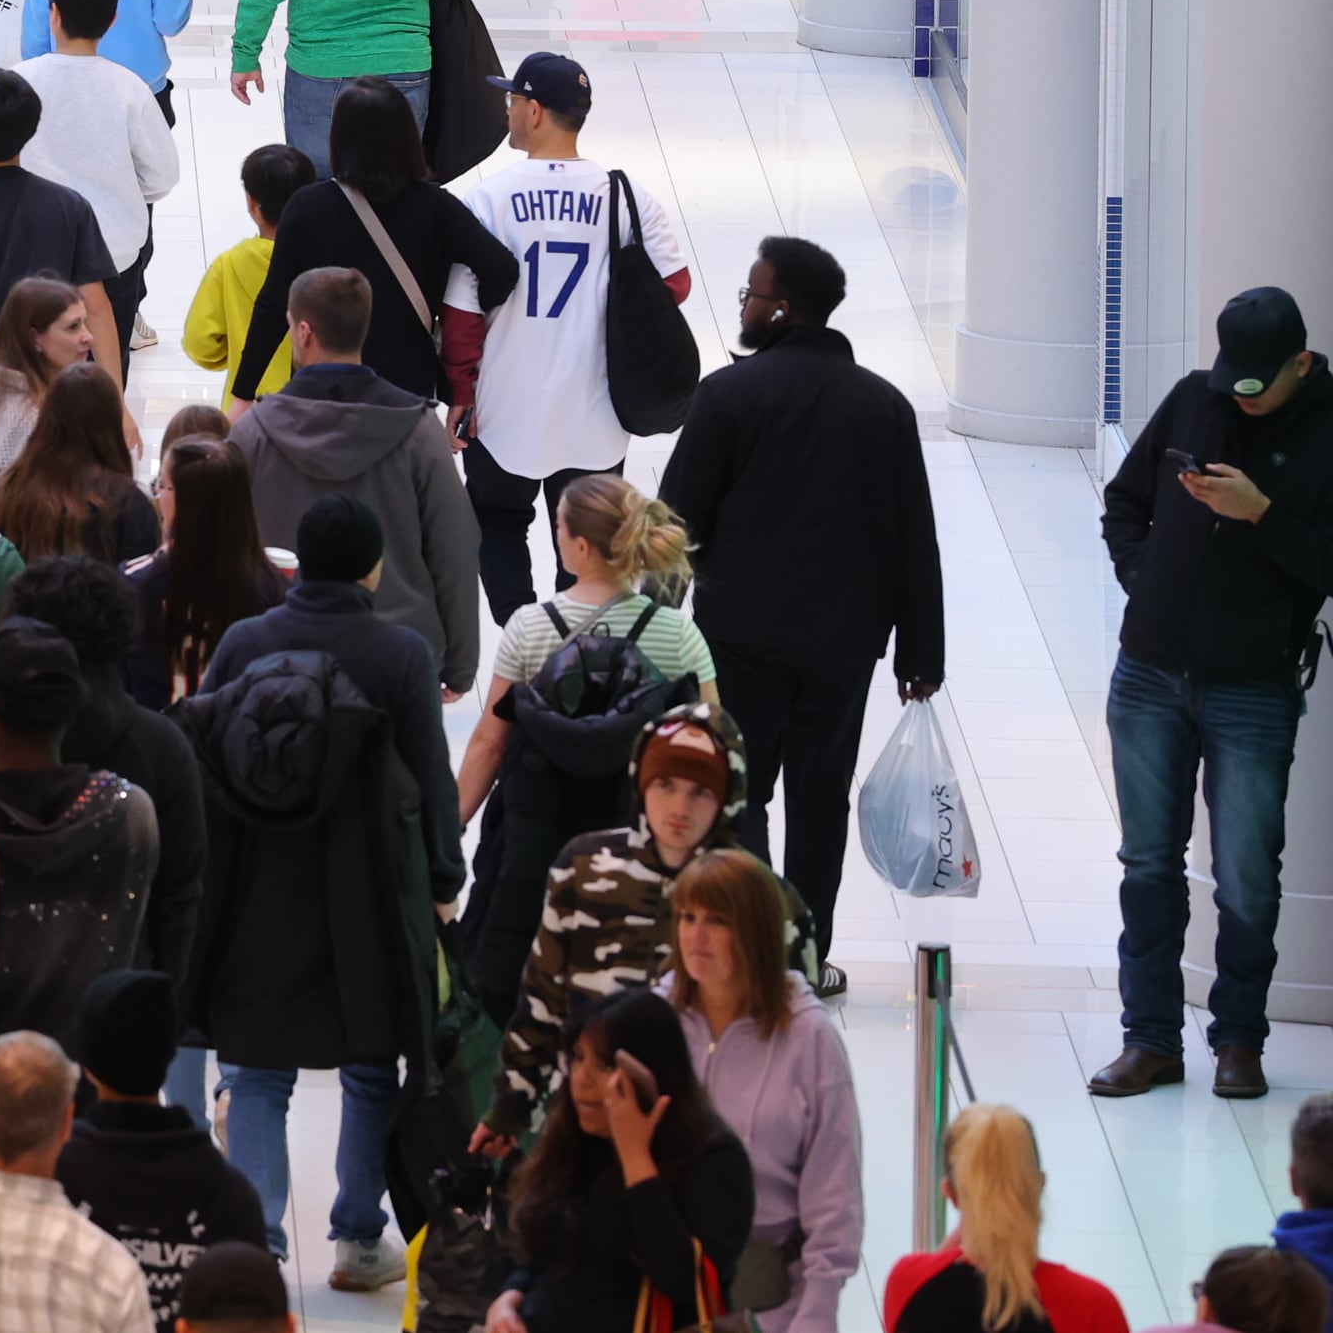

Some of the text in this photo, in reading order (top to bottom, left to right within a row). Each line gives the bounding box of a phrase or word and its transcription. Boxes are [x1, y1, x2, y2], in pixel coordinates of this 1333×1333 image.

[510, 189, 602, 227] OHTANI
[523, 240, 590, 318] 17
[932, 784, 955, 890] macy's
